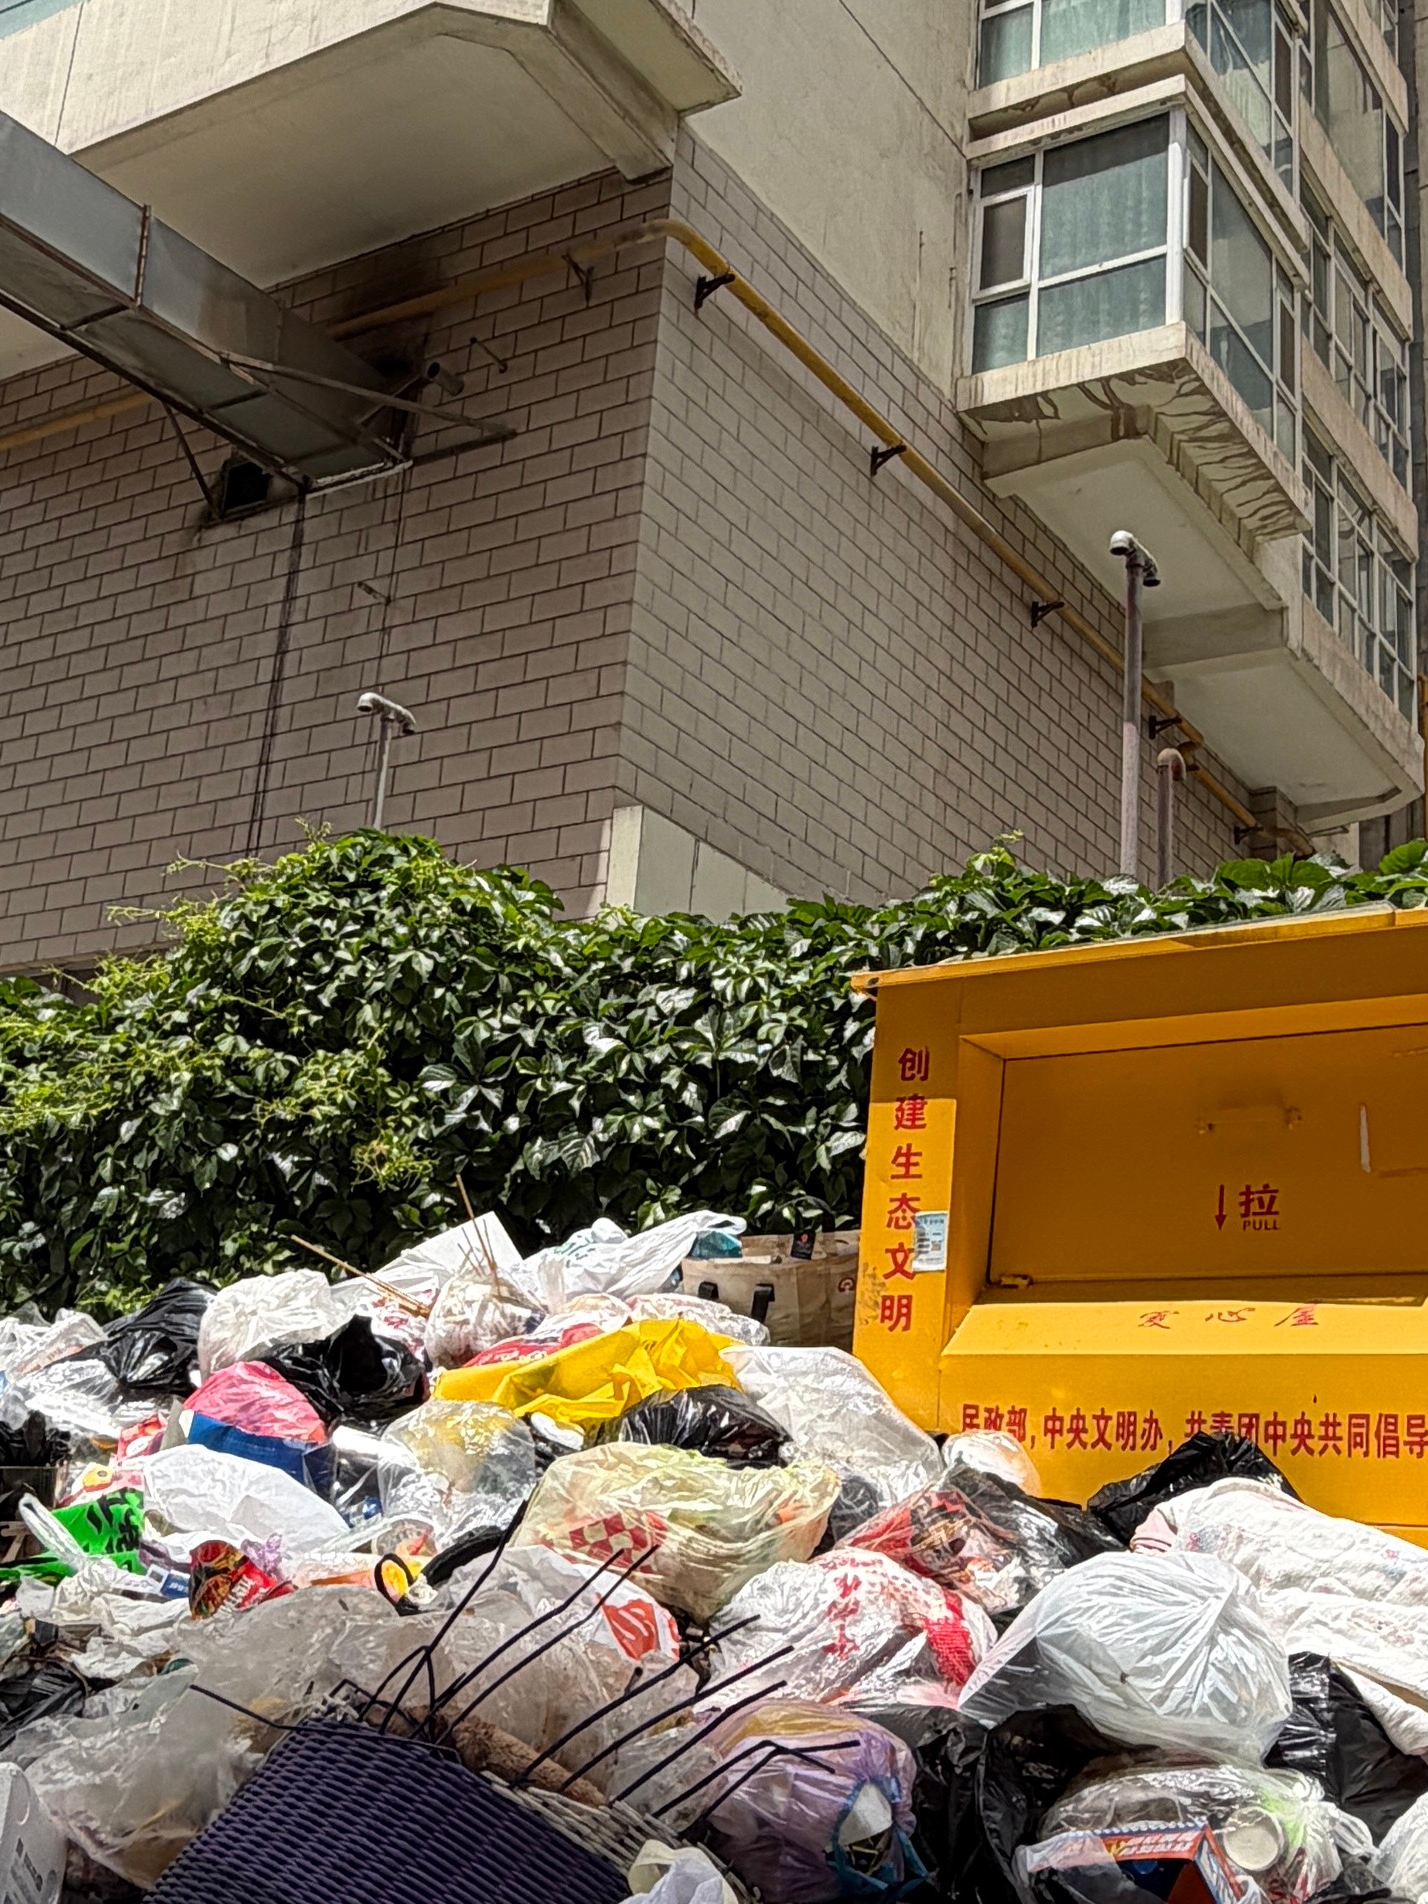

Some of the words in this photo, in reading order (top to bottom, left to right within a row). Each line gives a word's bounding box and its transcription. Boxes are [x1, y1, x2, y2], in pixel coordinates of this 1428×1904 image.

[879, 1046, 931, 1333] 创建生态文明
[1239, 1183, 1279, 1218] 拉
[1242, 1219, 1281, 1232] PULL
